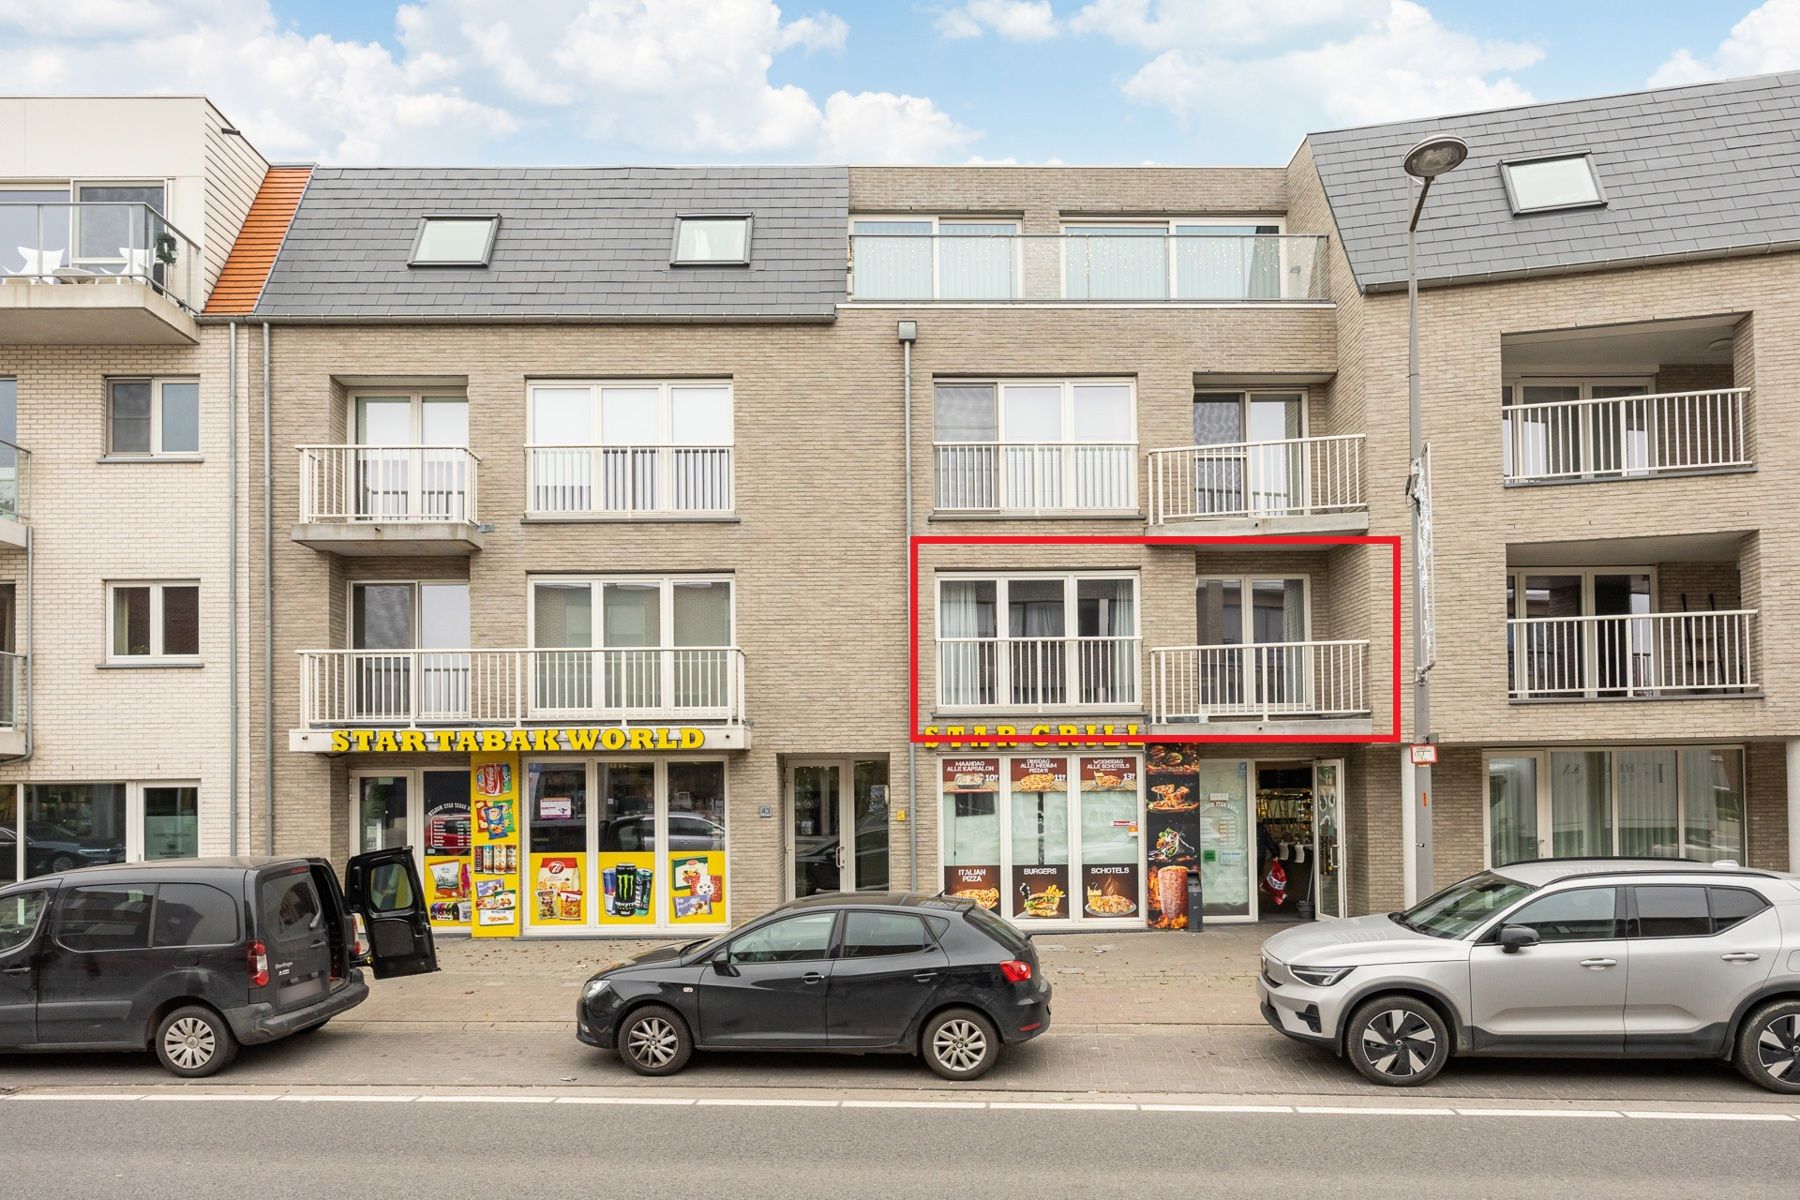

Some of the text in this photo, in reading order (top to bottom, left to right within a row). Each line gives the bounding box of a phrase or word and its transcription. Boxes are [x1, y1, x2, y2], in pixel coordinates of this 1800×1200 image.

[331, 727, 705, 752] STAR TABAK WORLD
[924, 723, 1145, 748] STAR GRILL
[761, 807, 771, 815] 43
